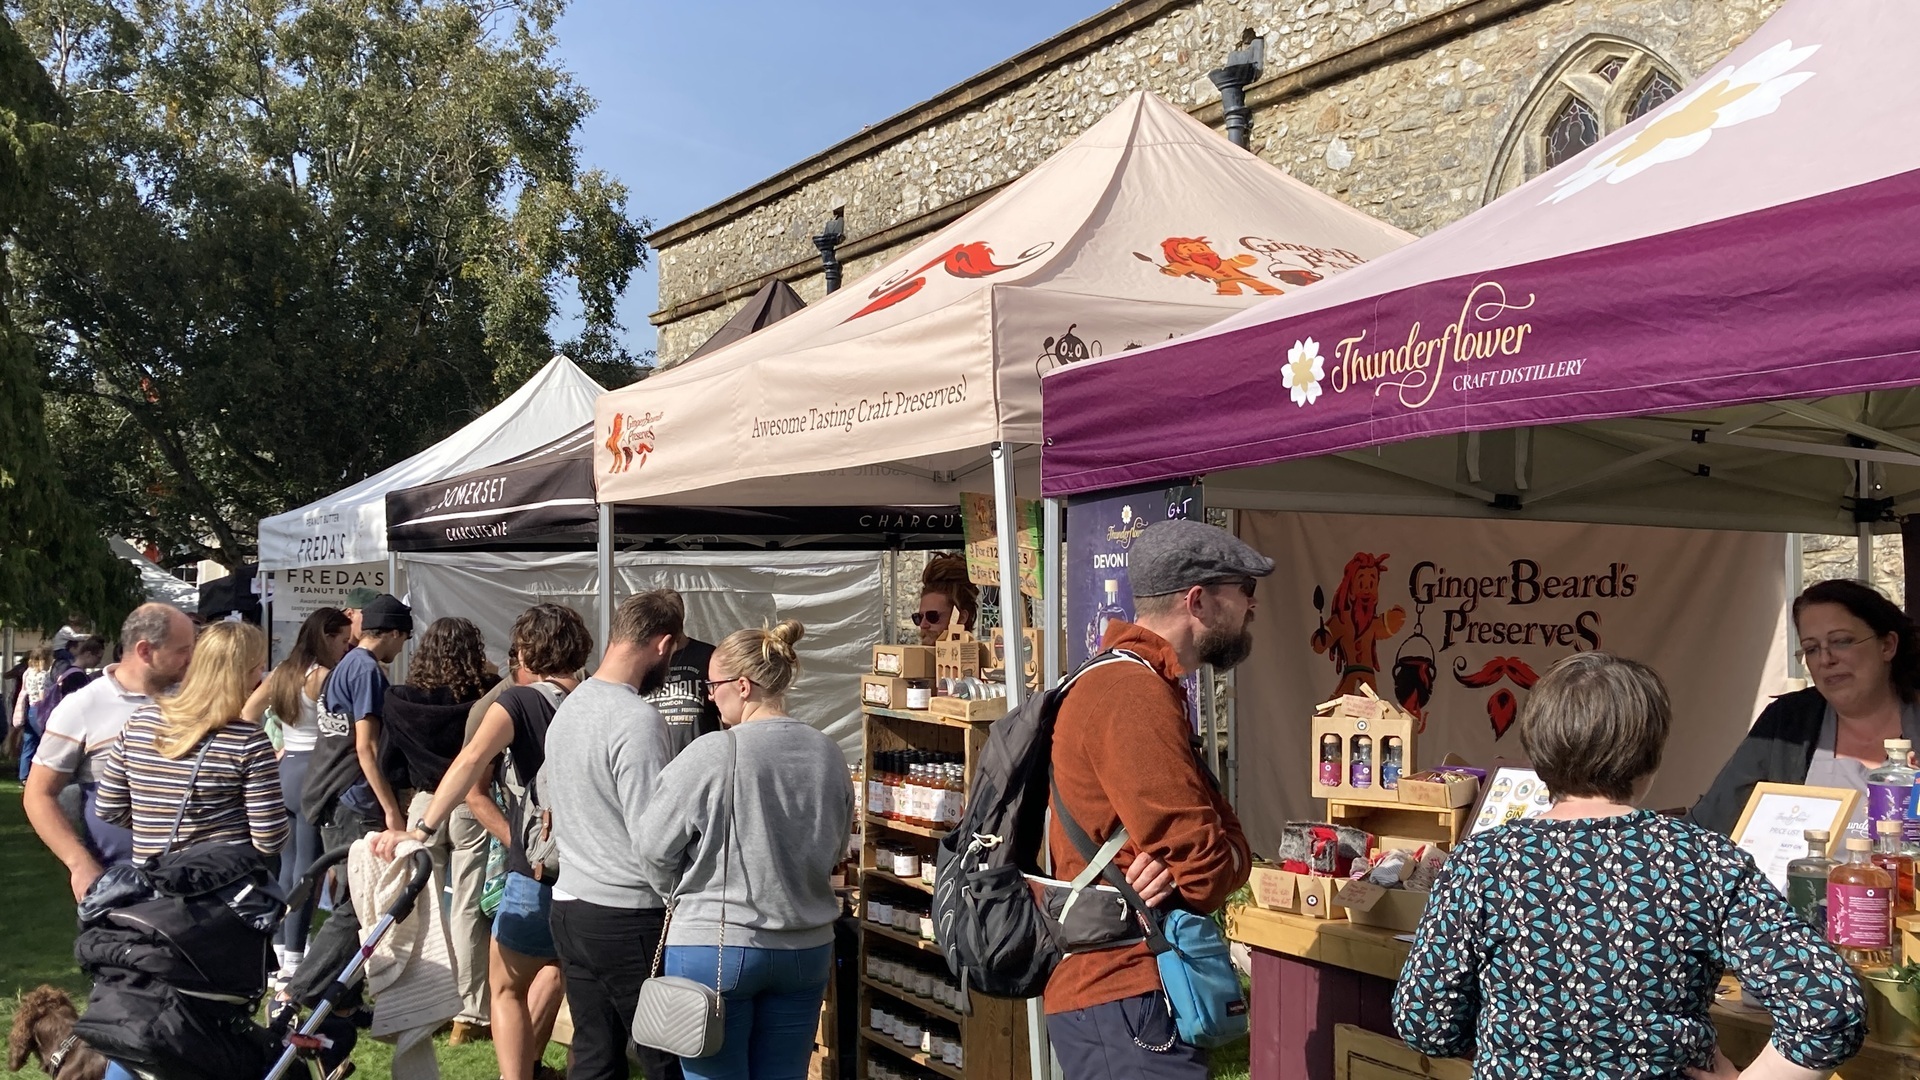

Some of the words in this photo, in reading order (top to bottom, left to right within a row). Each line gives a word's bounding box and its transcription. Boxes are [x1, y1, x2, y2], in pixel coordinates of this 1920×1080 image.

[1332, 281, 1535, 408] Thunderflower
[1452, 370, 1499, 391] CRAFT
[1499, 358, 1587, 385] DISTILLERY
[752, 414, 807, 438] Awesome
[809, 402, 855, 432] Tasting
[858, 391, 893, 423] Craft
[894, 374, 968, 416] Preserves!
[438, 477, 507, 508] SOMERSET
[446, 521, 507, 541] CHARCUTERIE
[859, 514, 962, 528] CHARCU
[297, 533, 346, 562] FREDA'S
[1093, 553, 1124, 569] DEVON
[287, 569, 384, 587] FREDA'S
[294, 587, 334, 595] PEANUT
[1505, 810, 1524, 818] GIN
